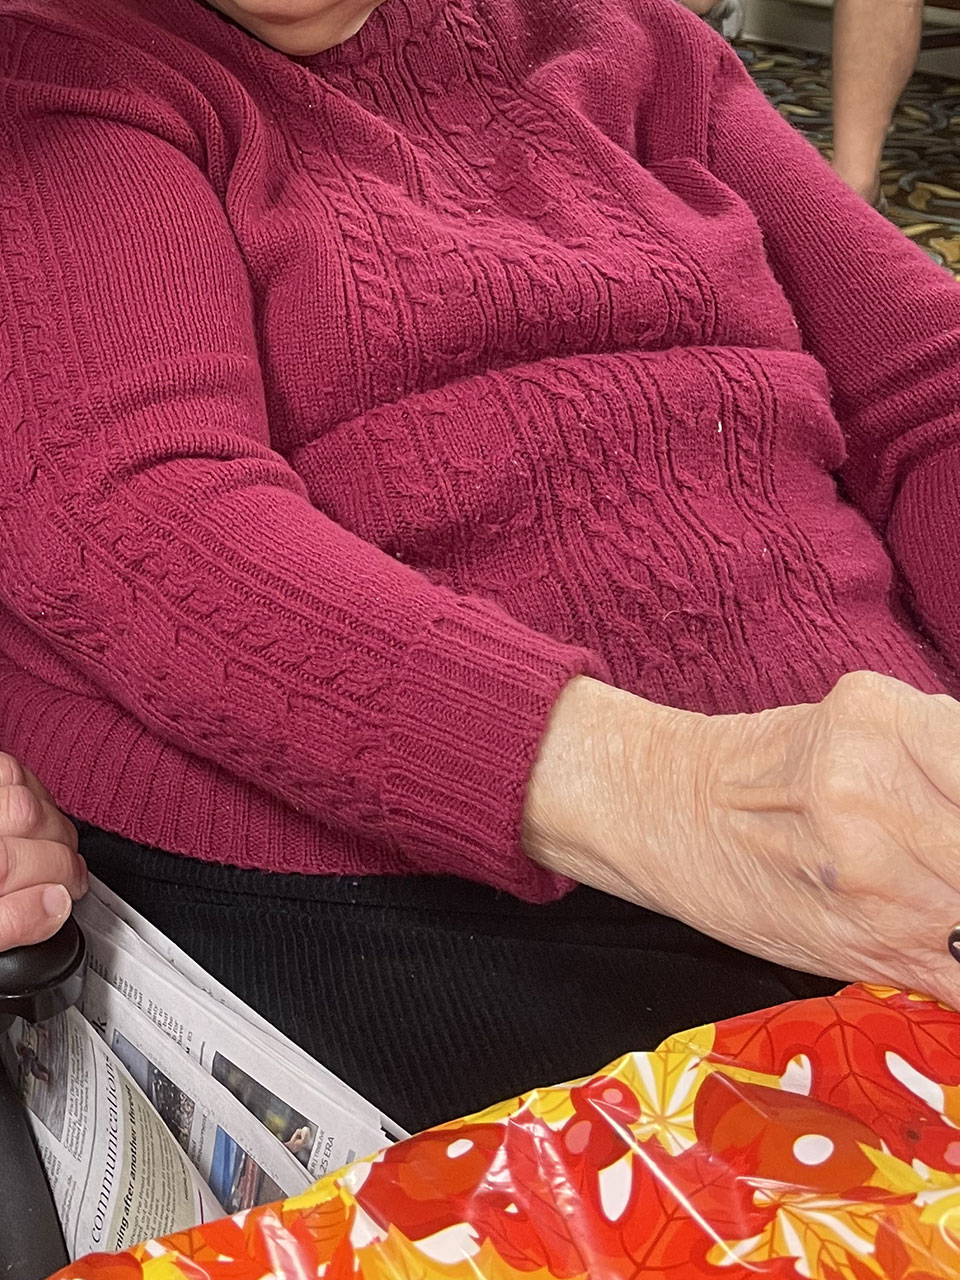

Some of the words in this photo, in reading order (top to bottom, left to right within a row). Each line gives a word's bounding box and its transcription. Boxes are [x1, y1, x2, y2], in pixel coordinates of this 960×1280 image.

[126, 1085, 135, 1125] threat
[130, 1129, 138, 1181] another
[324, 1137, 334, 1159] ERA
[121, 1180, 134, 1216] after
